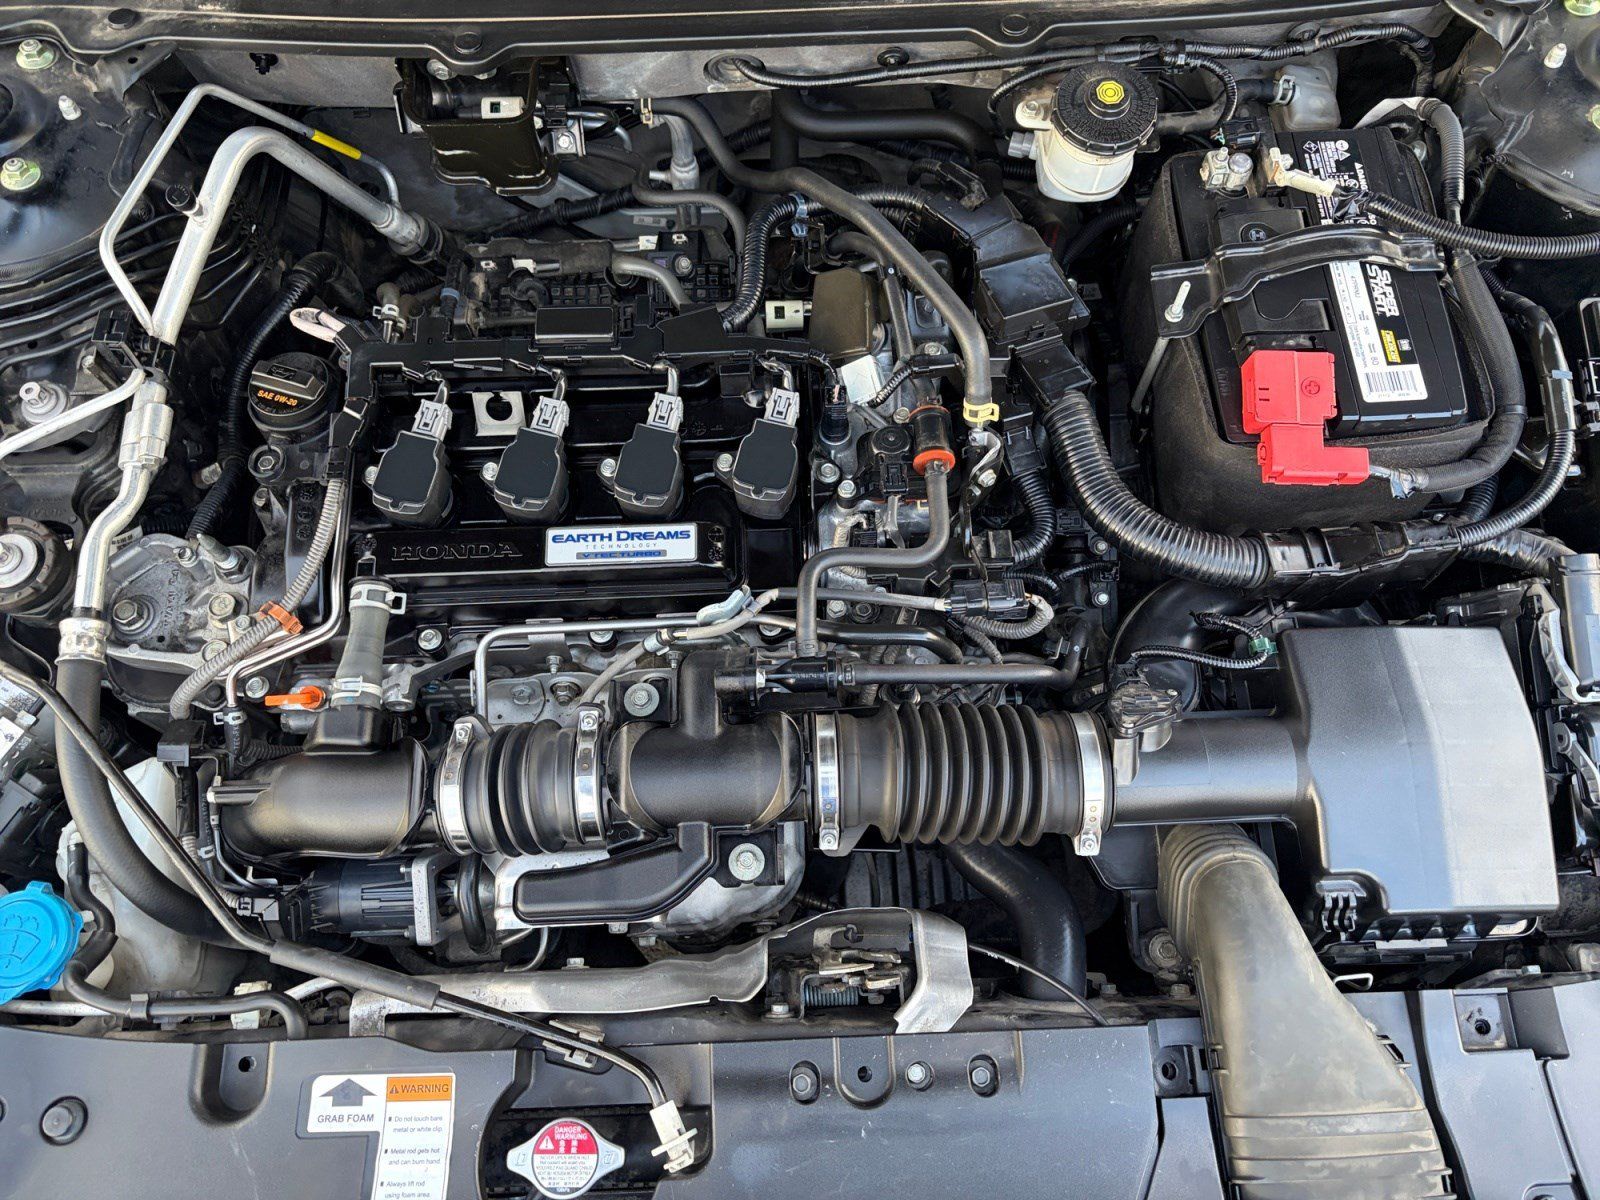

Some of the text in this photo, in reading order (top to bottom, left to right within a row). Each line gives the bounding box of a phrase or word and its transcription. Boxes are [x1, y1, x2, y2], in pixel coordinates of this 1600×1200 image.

[1366, 264, 1388, 316] START
[1380, 270, 1400, 318] SUPER
[257, 390, 274, 400] SAE
[552, 530, 691, 544] EARTH DREAMS
[391, 543, 523, 561] HONDA
[401, 1084, 449, 1093] WARNING
[318, 1114, 374, 1123] GRAB FOAM
